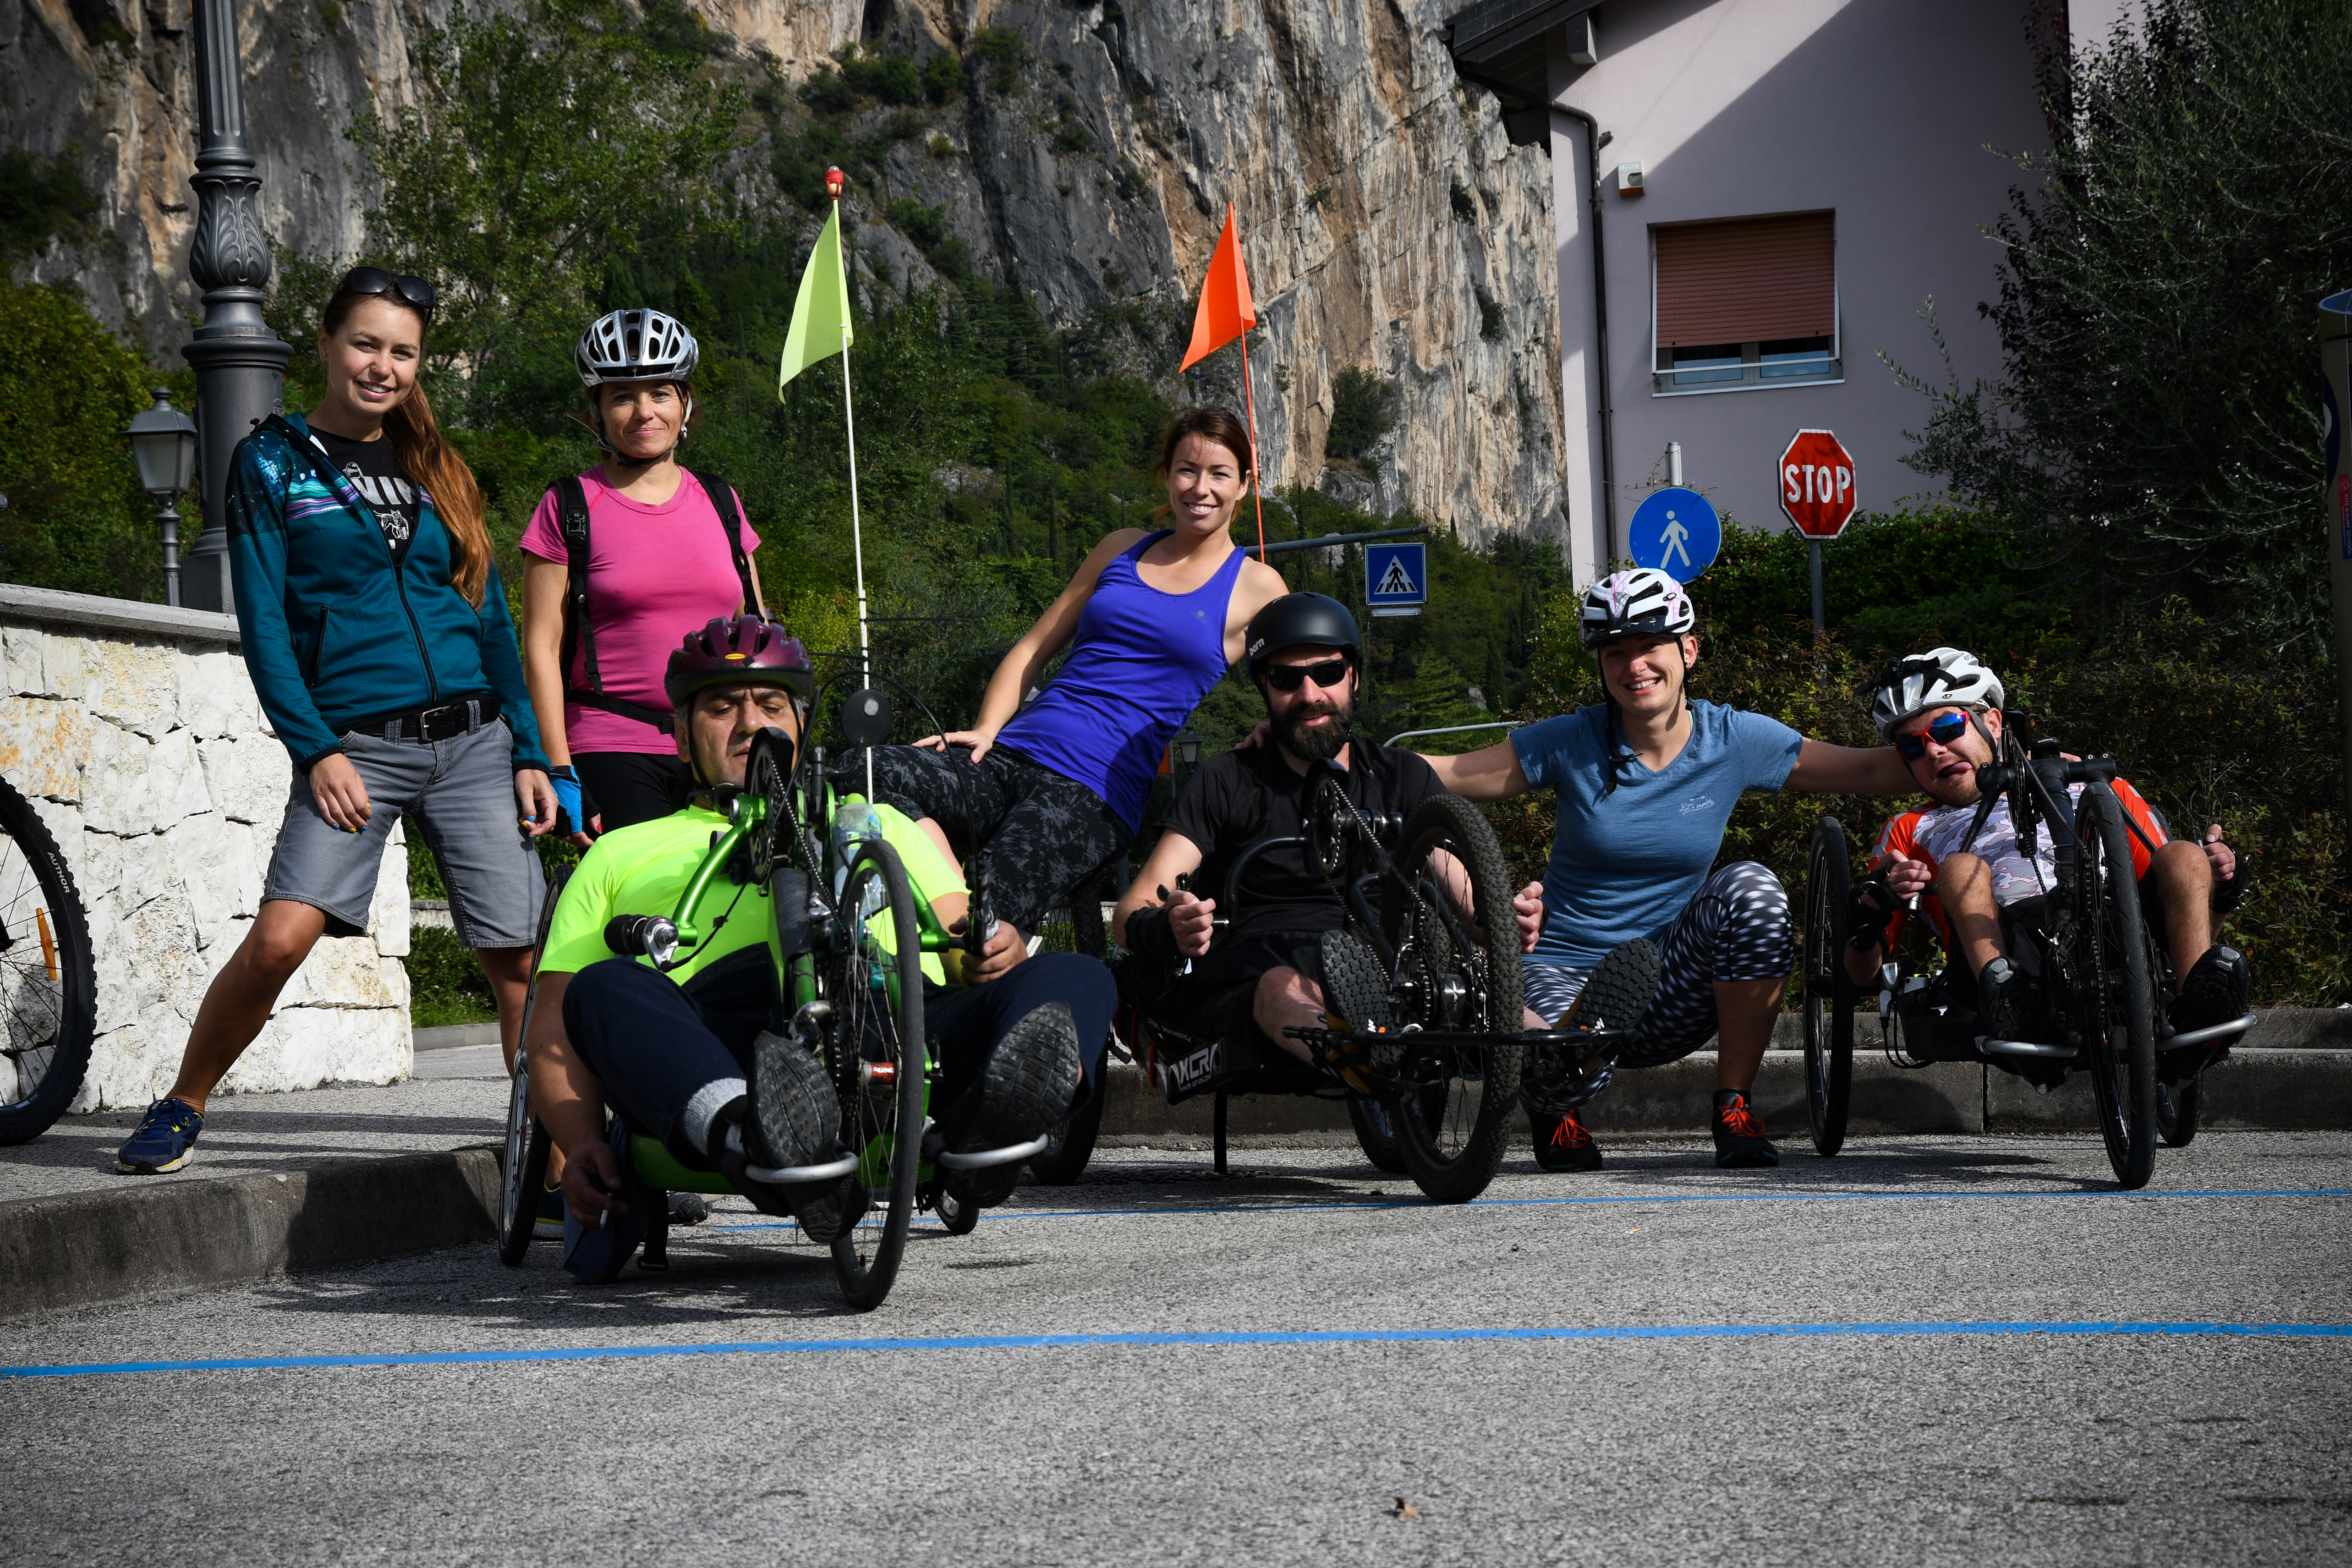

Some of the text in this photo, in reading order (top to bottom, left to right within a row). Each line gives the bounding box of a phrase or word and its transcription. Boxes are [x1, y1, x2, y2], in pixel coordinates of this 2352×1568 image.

[1785, 464, 1851, 504] STOP
[1249, 638, 1265, 657] bern
[47, 852, 70, 894] AUTHOR
[1179, 1047, 1210, 1084] XCR
